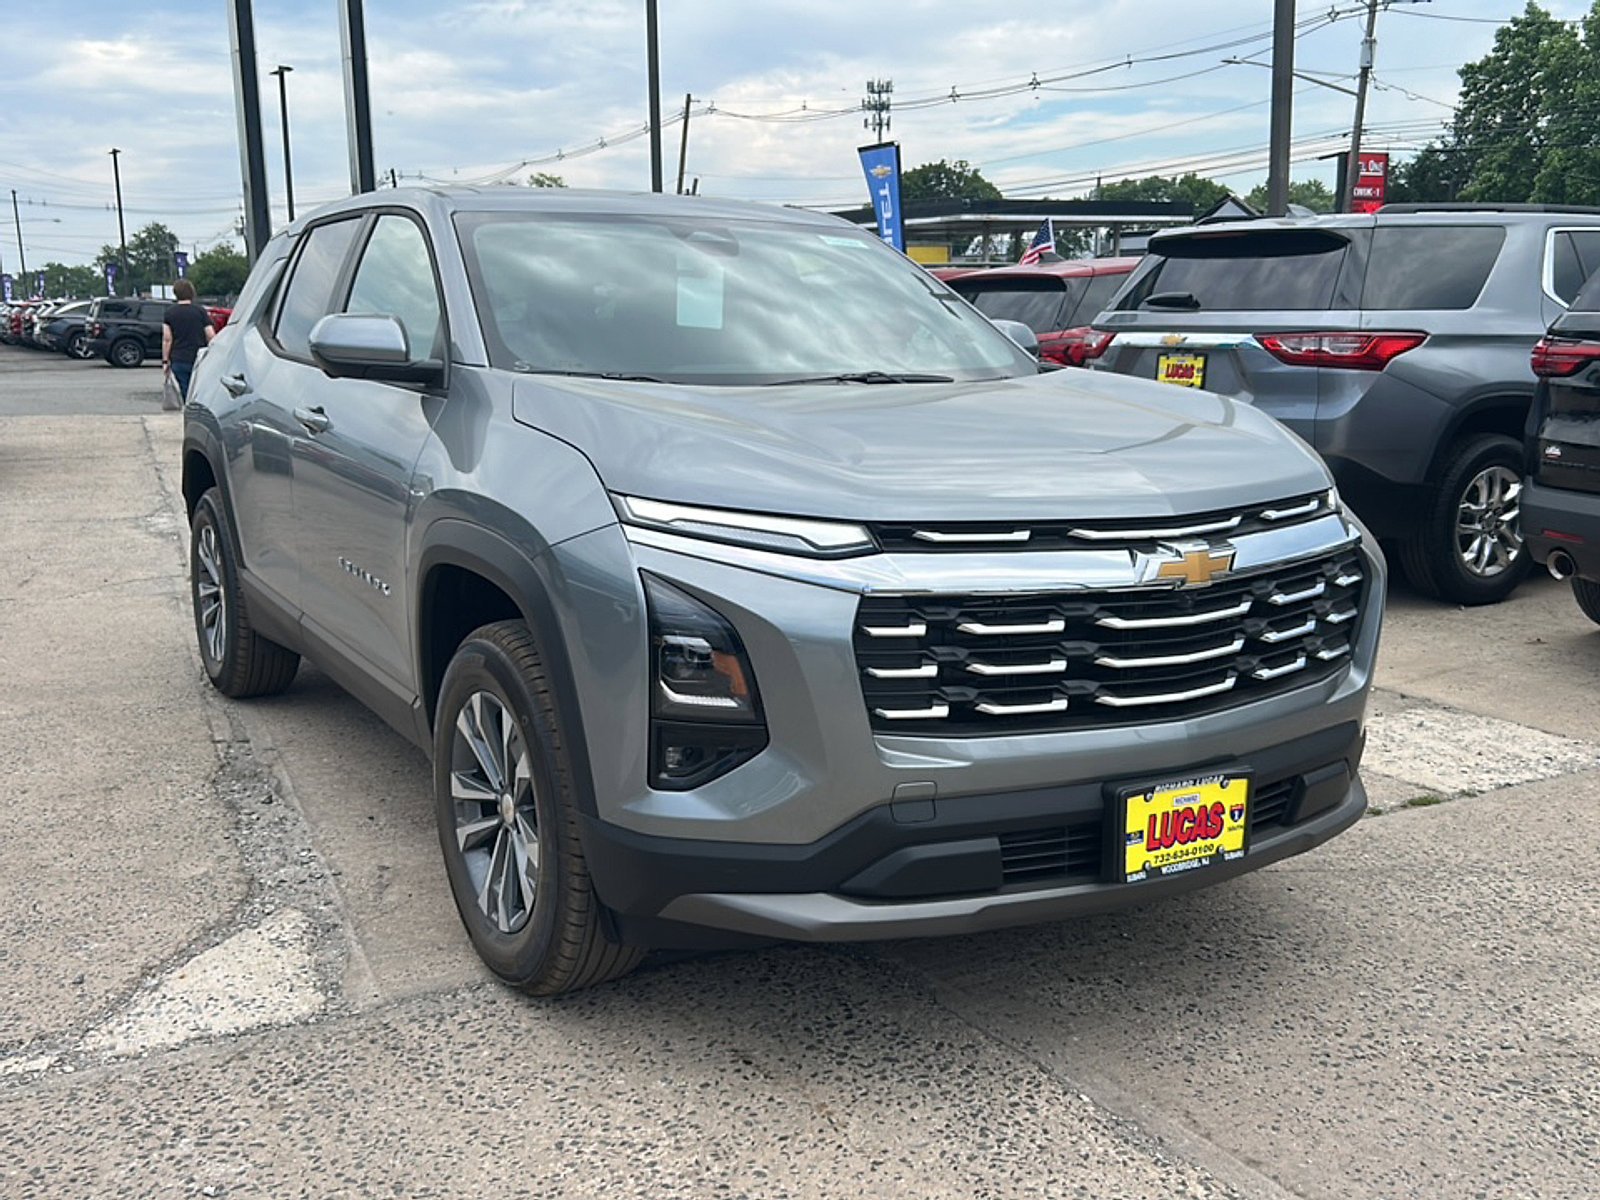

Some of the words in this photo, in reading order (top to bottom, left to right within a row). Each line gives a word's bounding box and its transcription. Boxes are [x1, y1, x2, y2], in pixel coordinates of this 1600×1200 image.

[1165, 363, 1195, 379] LUCAS
[1196, 775, 1225, 787] LUCAS
[1145, 801, 1225, 852] LUCAS
[1153, 843, 1215, 864] 732-634-0100
